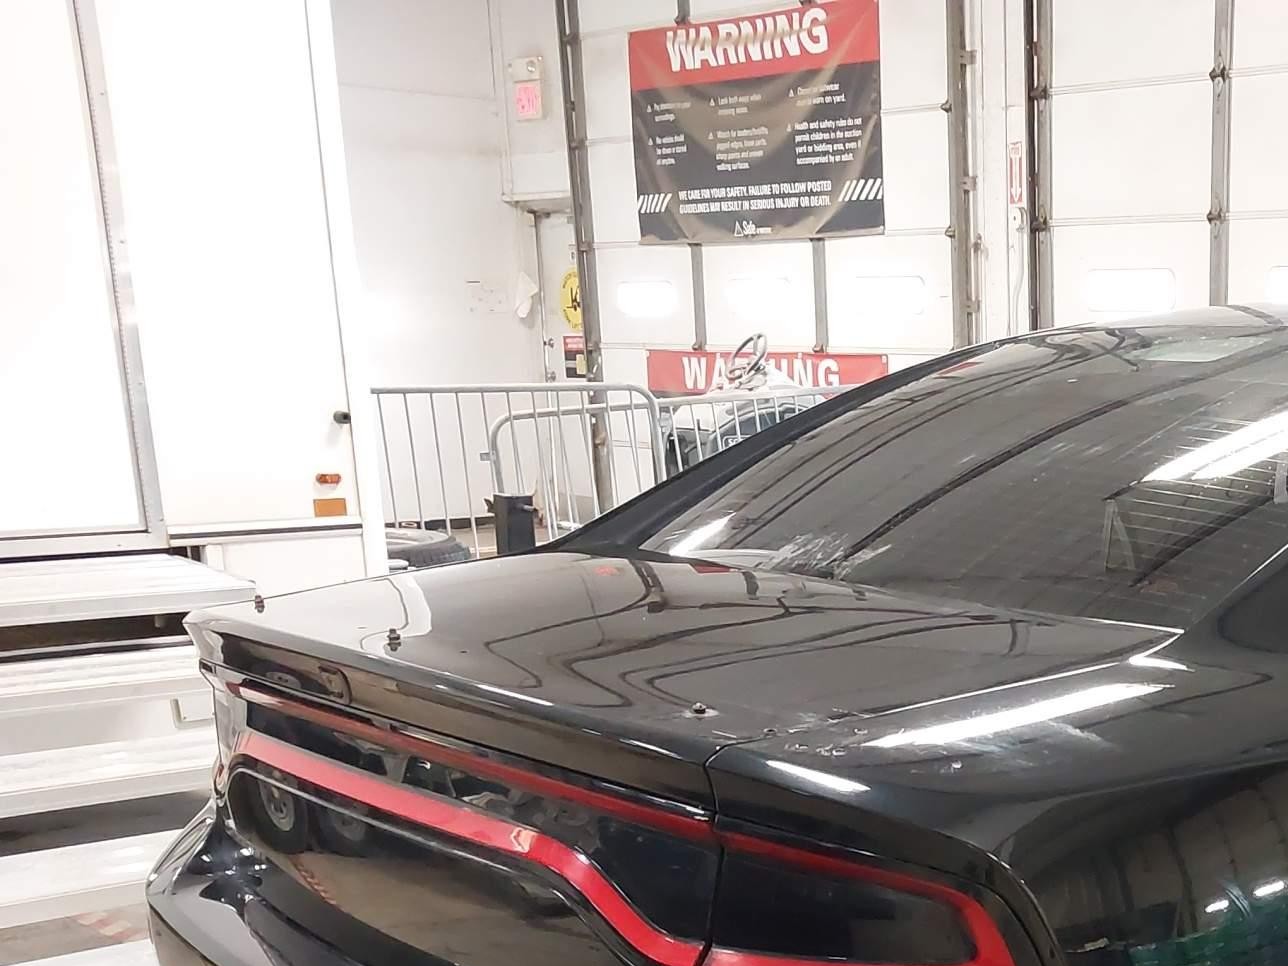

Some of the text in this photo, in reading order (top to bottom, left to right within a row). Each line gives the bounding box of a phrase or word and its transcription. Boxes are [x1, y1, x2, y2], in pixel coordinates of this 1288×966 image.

[666, 8, 828, 72] WARNING
[795, 121, 809, 130] Health
[810, 121, 818, 130] and
[820, 119, 835, 128] safety
[811, 131, 830, 140] children
[814, 142, 833, 153] bidding
[679, 191, 688, 200] WE
[688, 189, 701, 200] CARE
[711, 187, 726, 198] YOUR
[748, 184, 772, 196] FAILURE
[771, 184, 779, 194] TO
[780, 182, 807, 194] FOLLOW
[807, 181, 832, 192] POSTED
[721, 200, 742, 211] RESULT
[742, 200, 749, 210] IN
[750, 198, 775, 210] SERIOUS
[775, 197, 799, 208] INJURY
[800, 196, 810, 207] OR
[810, 195, 831, 206] DEATH.
[743, 220, 756, 235] Safe
[681, 356, 840, 390] WAING
